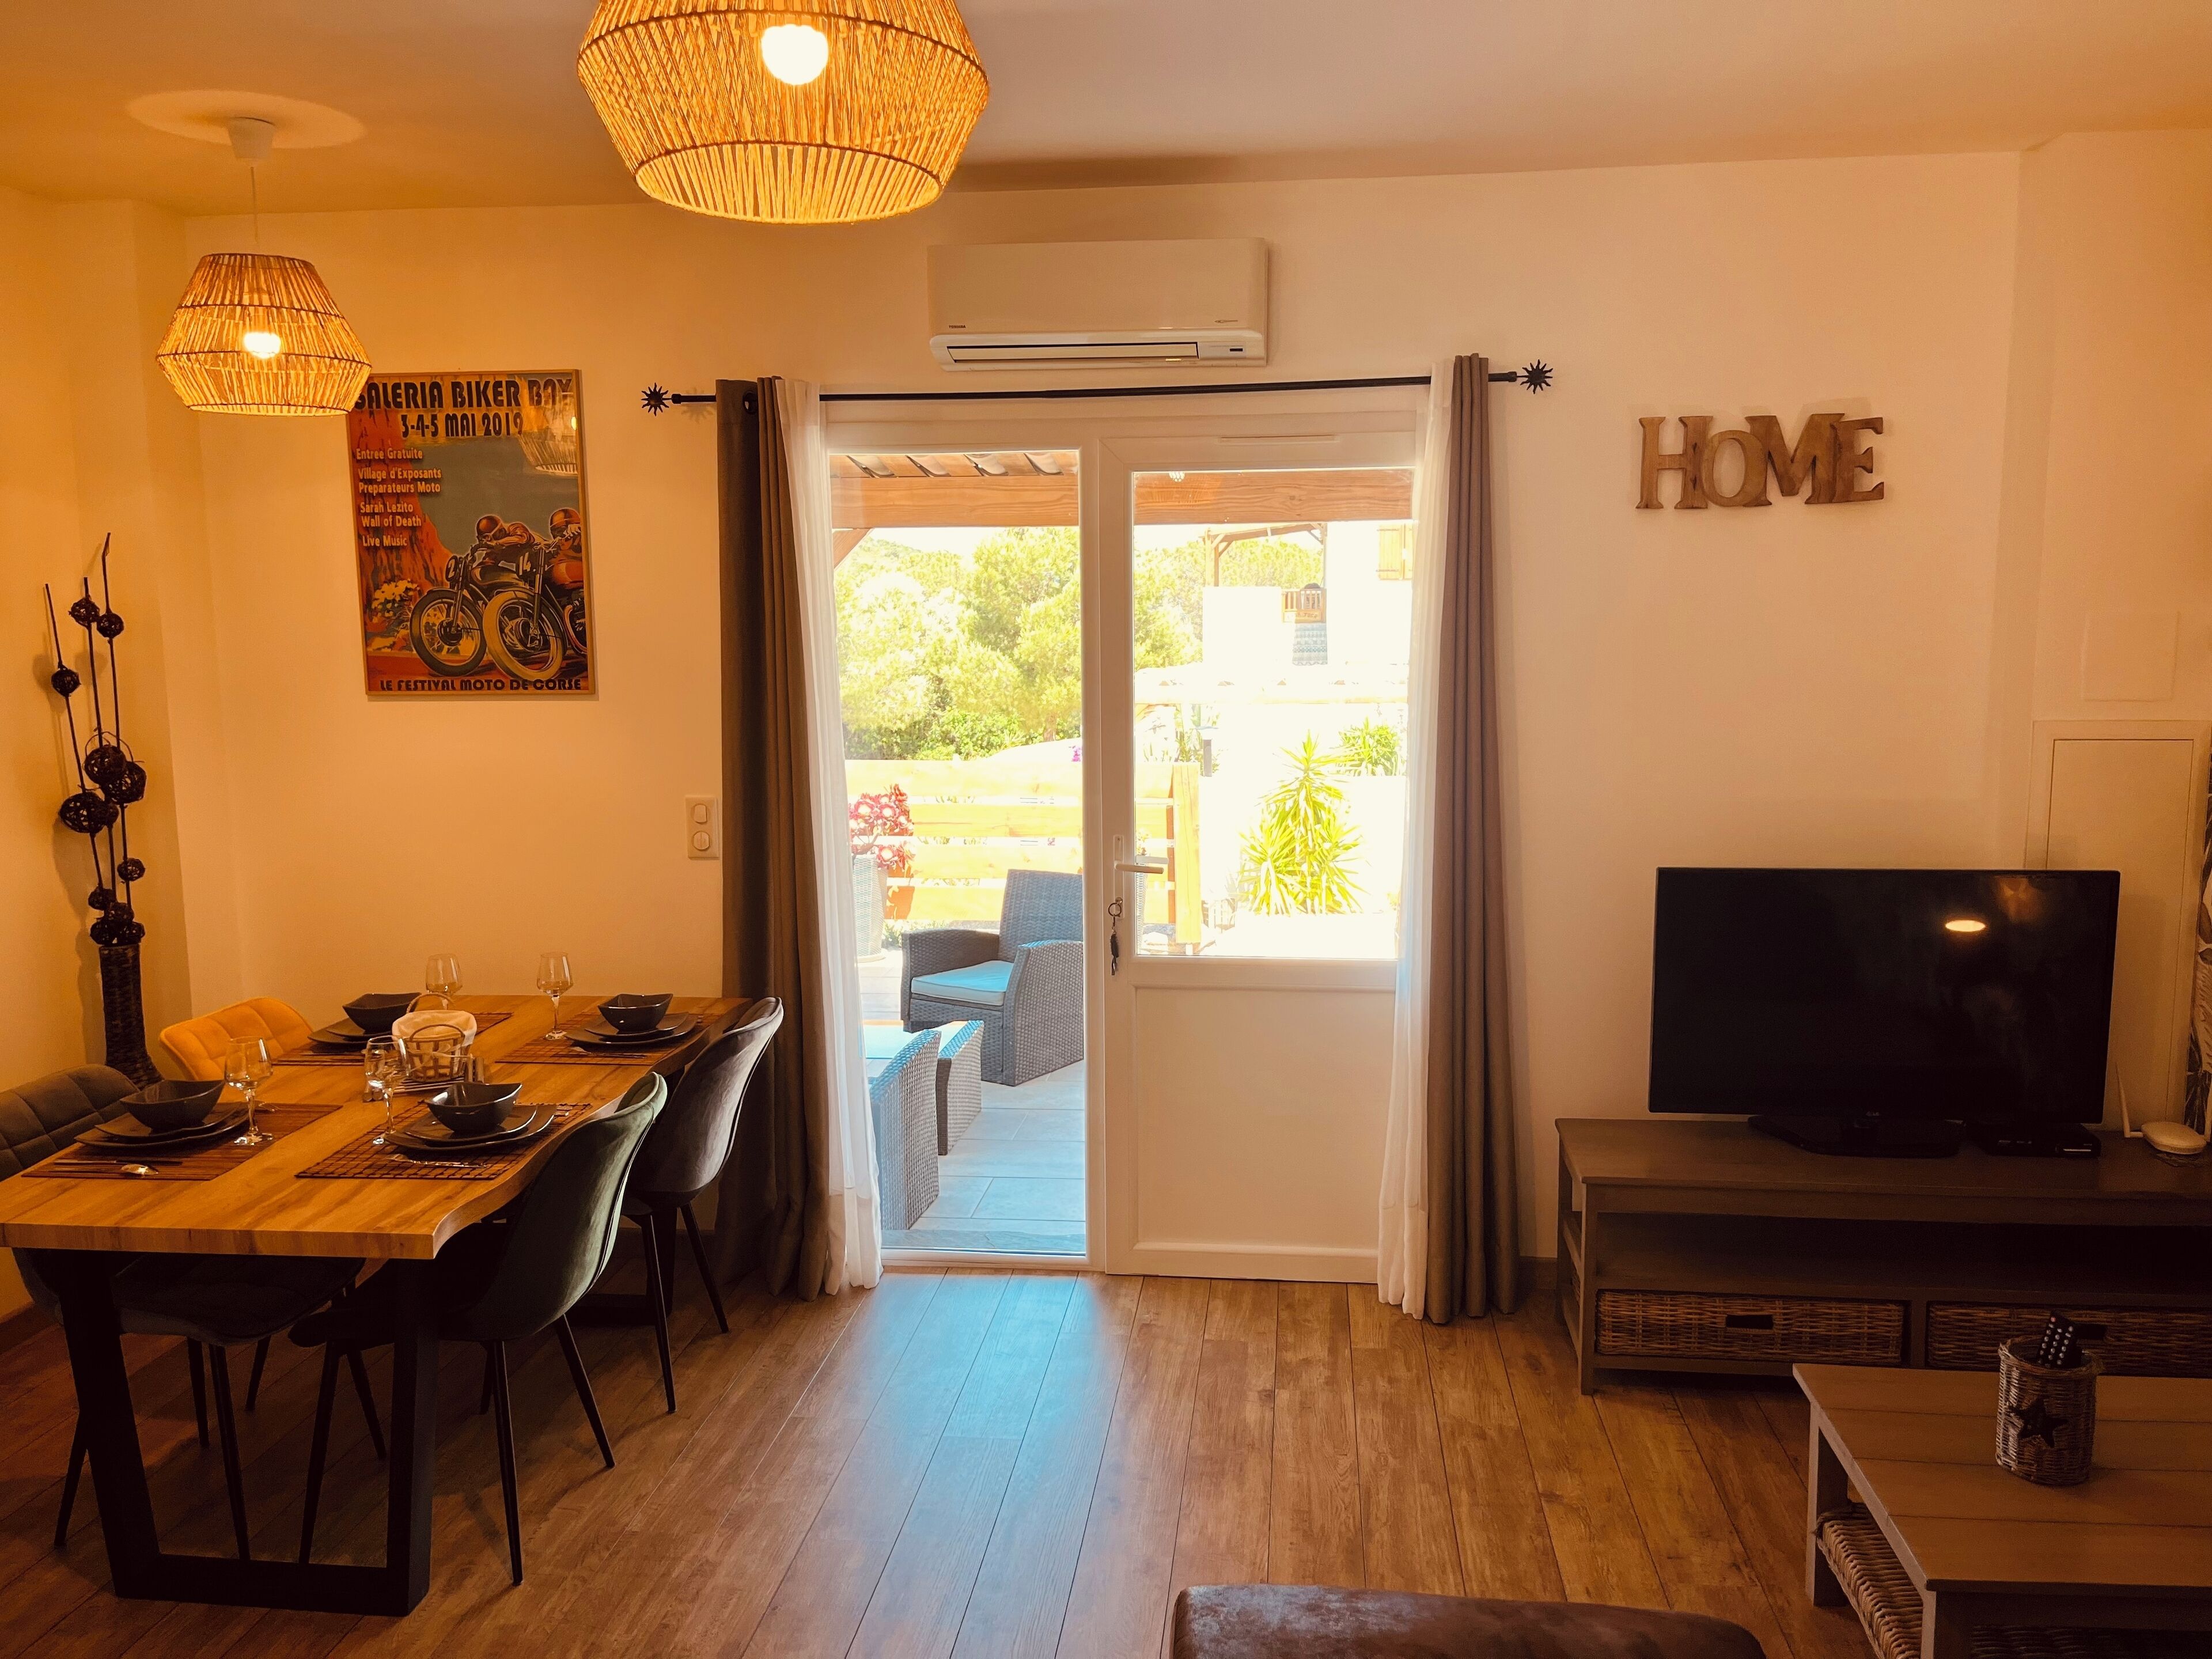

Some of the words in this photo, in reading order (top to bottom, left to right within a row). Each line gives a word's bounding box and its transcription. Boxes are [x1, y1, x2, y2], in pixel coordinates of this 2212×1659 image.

[354, 381, 443, 410] GALERIA
[451, 380, 521, 408] BIKER
[401, 414, 439, 438] 3-4-5
[445, 412, 476, 437] MAI
[482, 412, 524, 436] 2019
[387, 447, 423, 459] Gratuite
[1635, 413, 1885, 509] HOME
[358, 467, 387, 482] Village
[390, 468, 442, 482] d'Exposants
[359, 482, 414, 496] Preparateurs
[417, 482, 441, 493] Moto
[360, 501, 384, 513] Sarah
[387, 501, 414, 512] Lezito
[361, 515, 380, 527] Wall
[384, 515, 392, 527] of
[396, 515, 422, 527] Death
[362, 535, 380, 547] Live
[383, 535, 408, 546] Music
[380, 680, 393, 691] LE
[397, 680, 456, 691] FESTIVAL
[460, 679, 505, 691] MOTO
[510, 679, 528, 690] DE
[533, 679, 581, 690] CORSE
